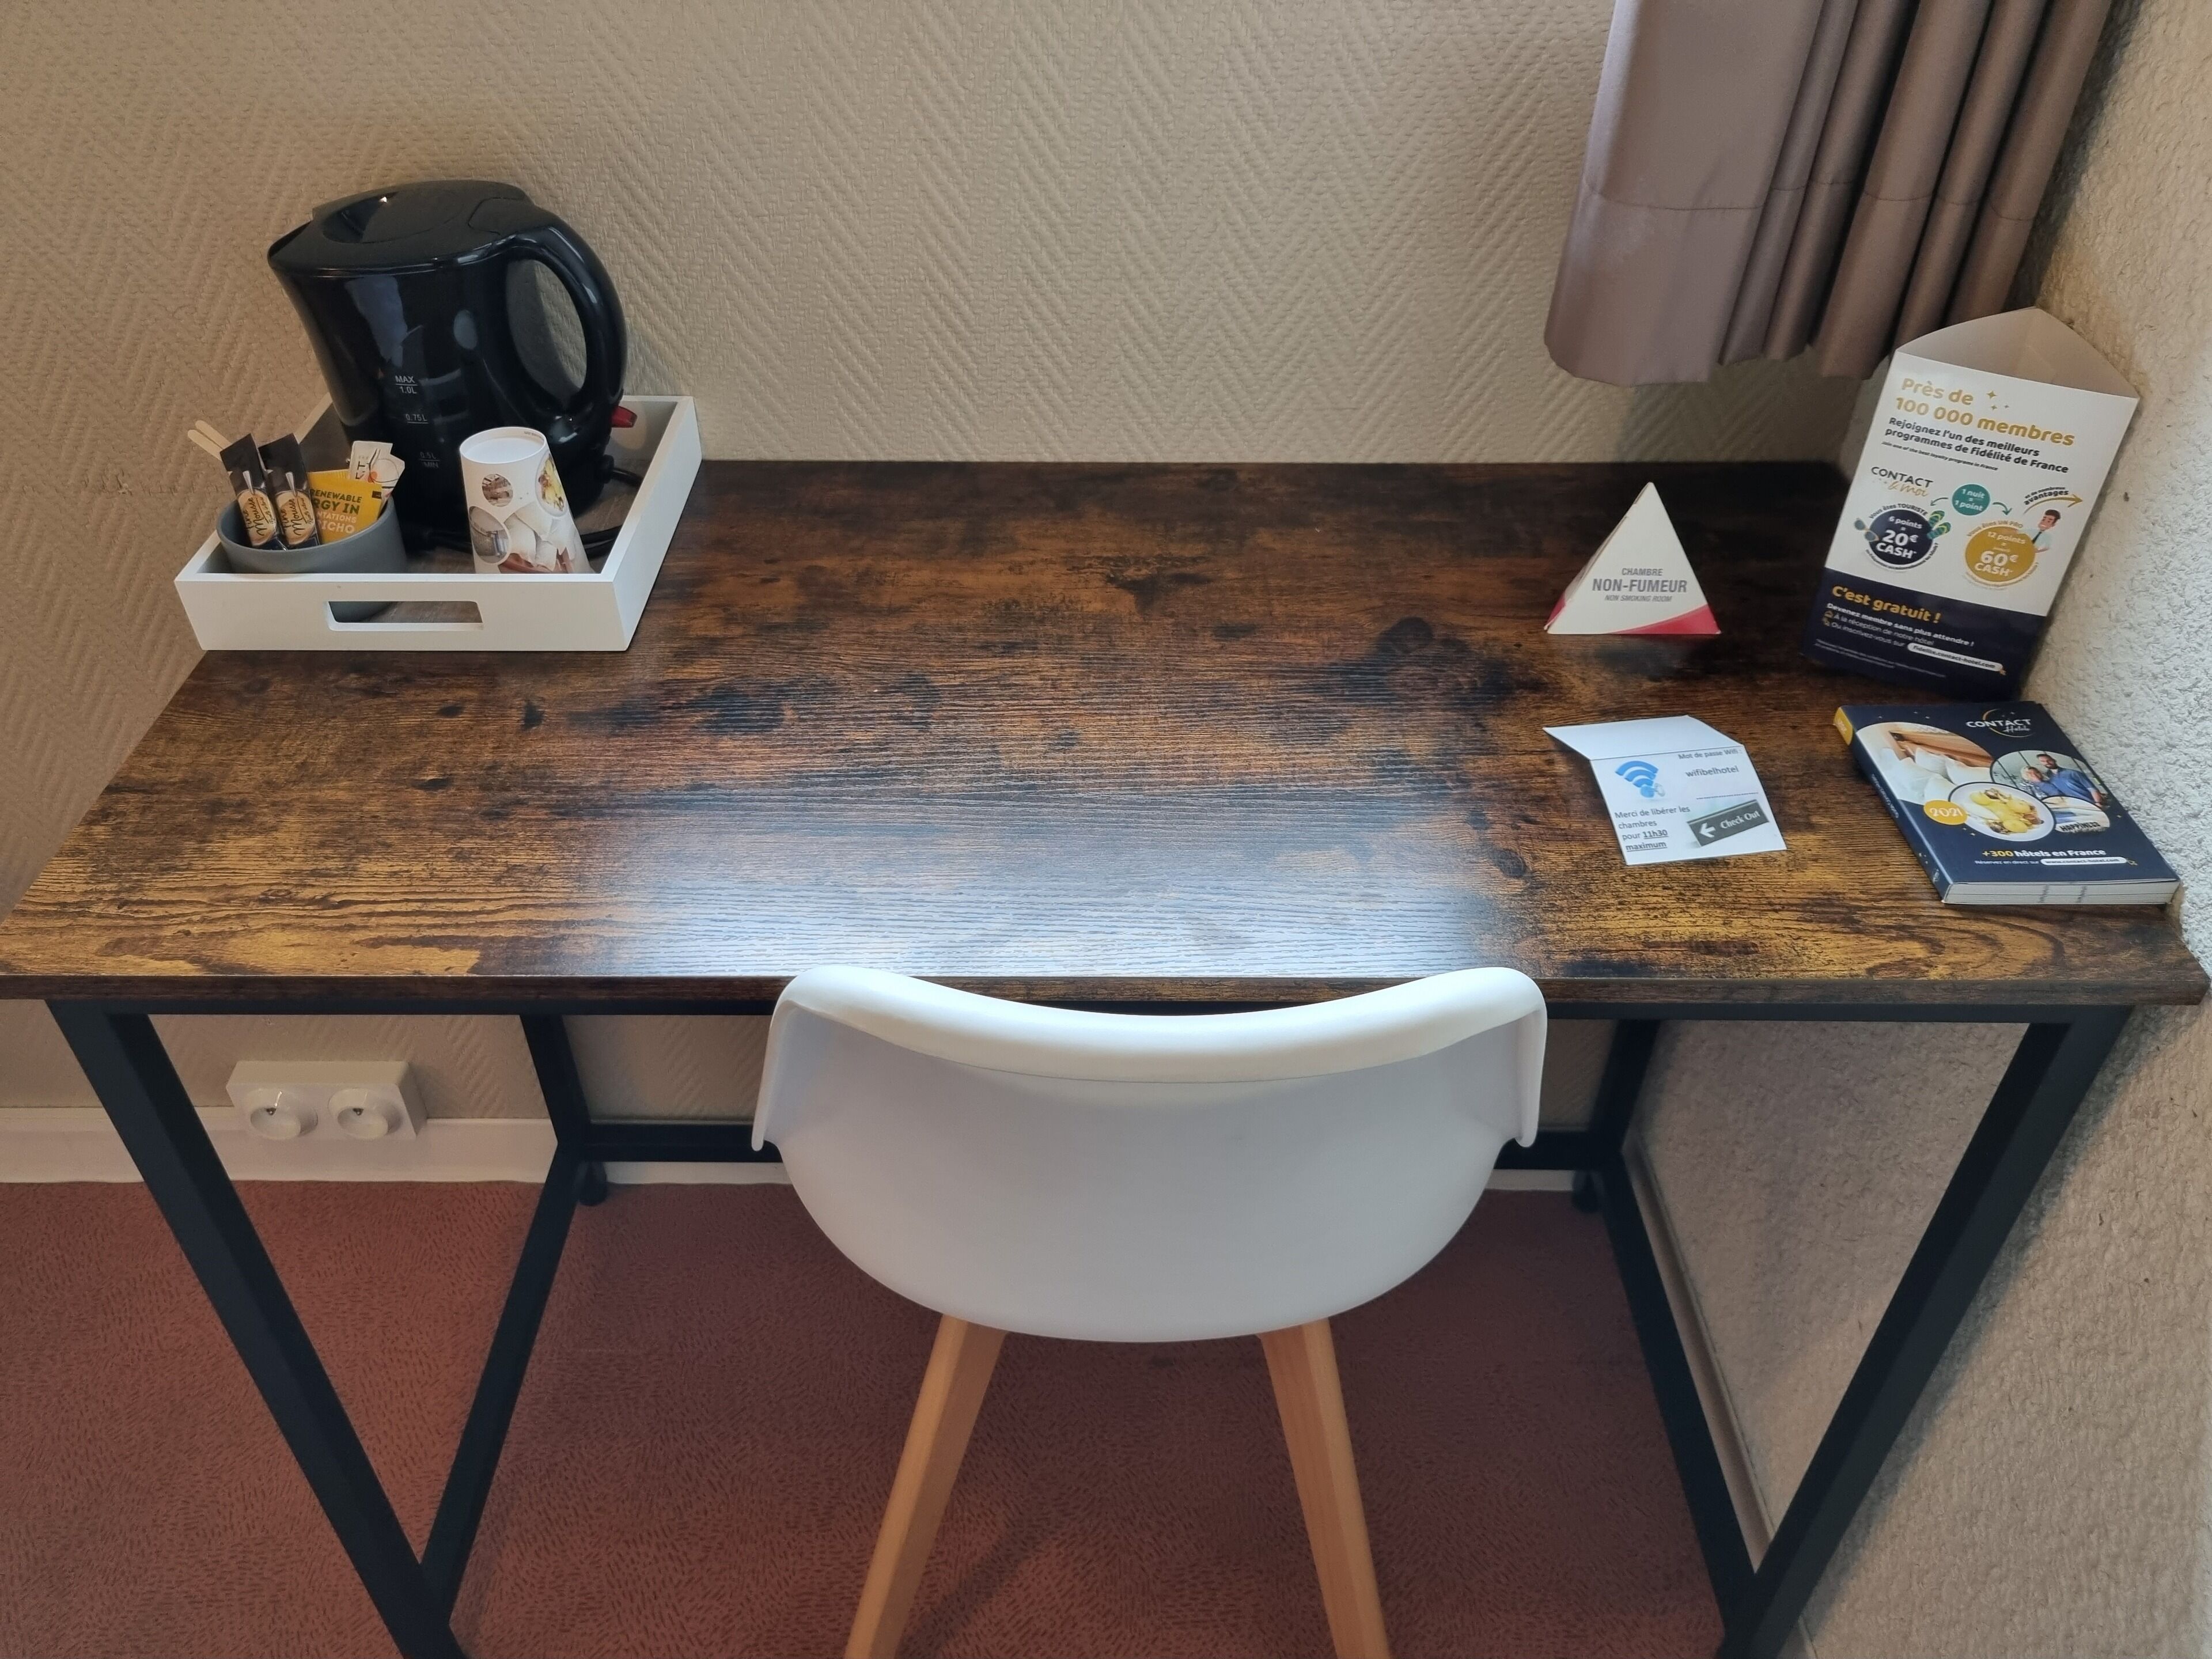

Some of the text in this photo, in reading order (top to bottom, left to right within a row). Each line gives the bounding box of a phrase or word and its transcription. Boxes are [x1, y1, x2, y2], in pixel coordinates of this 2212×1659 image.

[1902, 378, 1974, 406] Près de
[1896, 397, 2075, 446] 100 000 membres
[1889, 417, 2040, 456] Rejoignez l'un des meilleurs
[1885, 429, 1952, 450] programmes
[1955, 444, 1969, 453] de
[2014, 456, 2027, 465] de
[2030, 460, 2069, 474] France
[1871, 467, 1933, 488] CONTACT
[310, 488, 362, 503] RENEWABLE
[1967, 490, 1986, 499] nuit
[2024, 490, 2069, 505] avantages
[343, 503, 360, 515] IN
[1897, 503, 1929, 516] TOURISTE
[1960, 501, 1983, 512] point
[248, 497, 268, 536] Mousse
[289, 499, 305, 536] Mousse
[1895, 519, 1922, 529] points
[1882, 529, 1919, 546] 20€
[1997, 534, 2025, 544] points
[1981, 551, 2018, 566] 60€
[1622, 568, 1663, 576] CHAMBRE
[1592, 578, 1688, 593] NON-FUMEUR
[1832, 586, 1871, 605] C'est
[1872, 600, 1931, 621] gratuit
[1827, 603, 1861, 618] Devenez
[1861, 614, 1893, 626] membre
[1893, 623, 1913, 631] sans
[1914, 628, 1931, 637] plus
[1933, 634, 1969, 646] attendre
[1893, 632, 1914, 641] notre
[1965, 719, 2031, 728] CONTACT
[1678, 752, 1692, 760] Mot
[1705, 751, 1723, 759] passe
[1685, 766, 1739, 777] wifibelhotel
[1615, 810, 1638, 819] Merci
[1639, 808, 1650, 816] de
[1651, 806, 1677, 816] libérer
[1930, 808, 1963, 817] 2021
[1618, 819, 1657, 829] chambres
[1719, 810, 1760, 830] Check Out
[1622, 829, 1669, 841] pour 11h30
[1626, 841, 1667, 851] maximum
